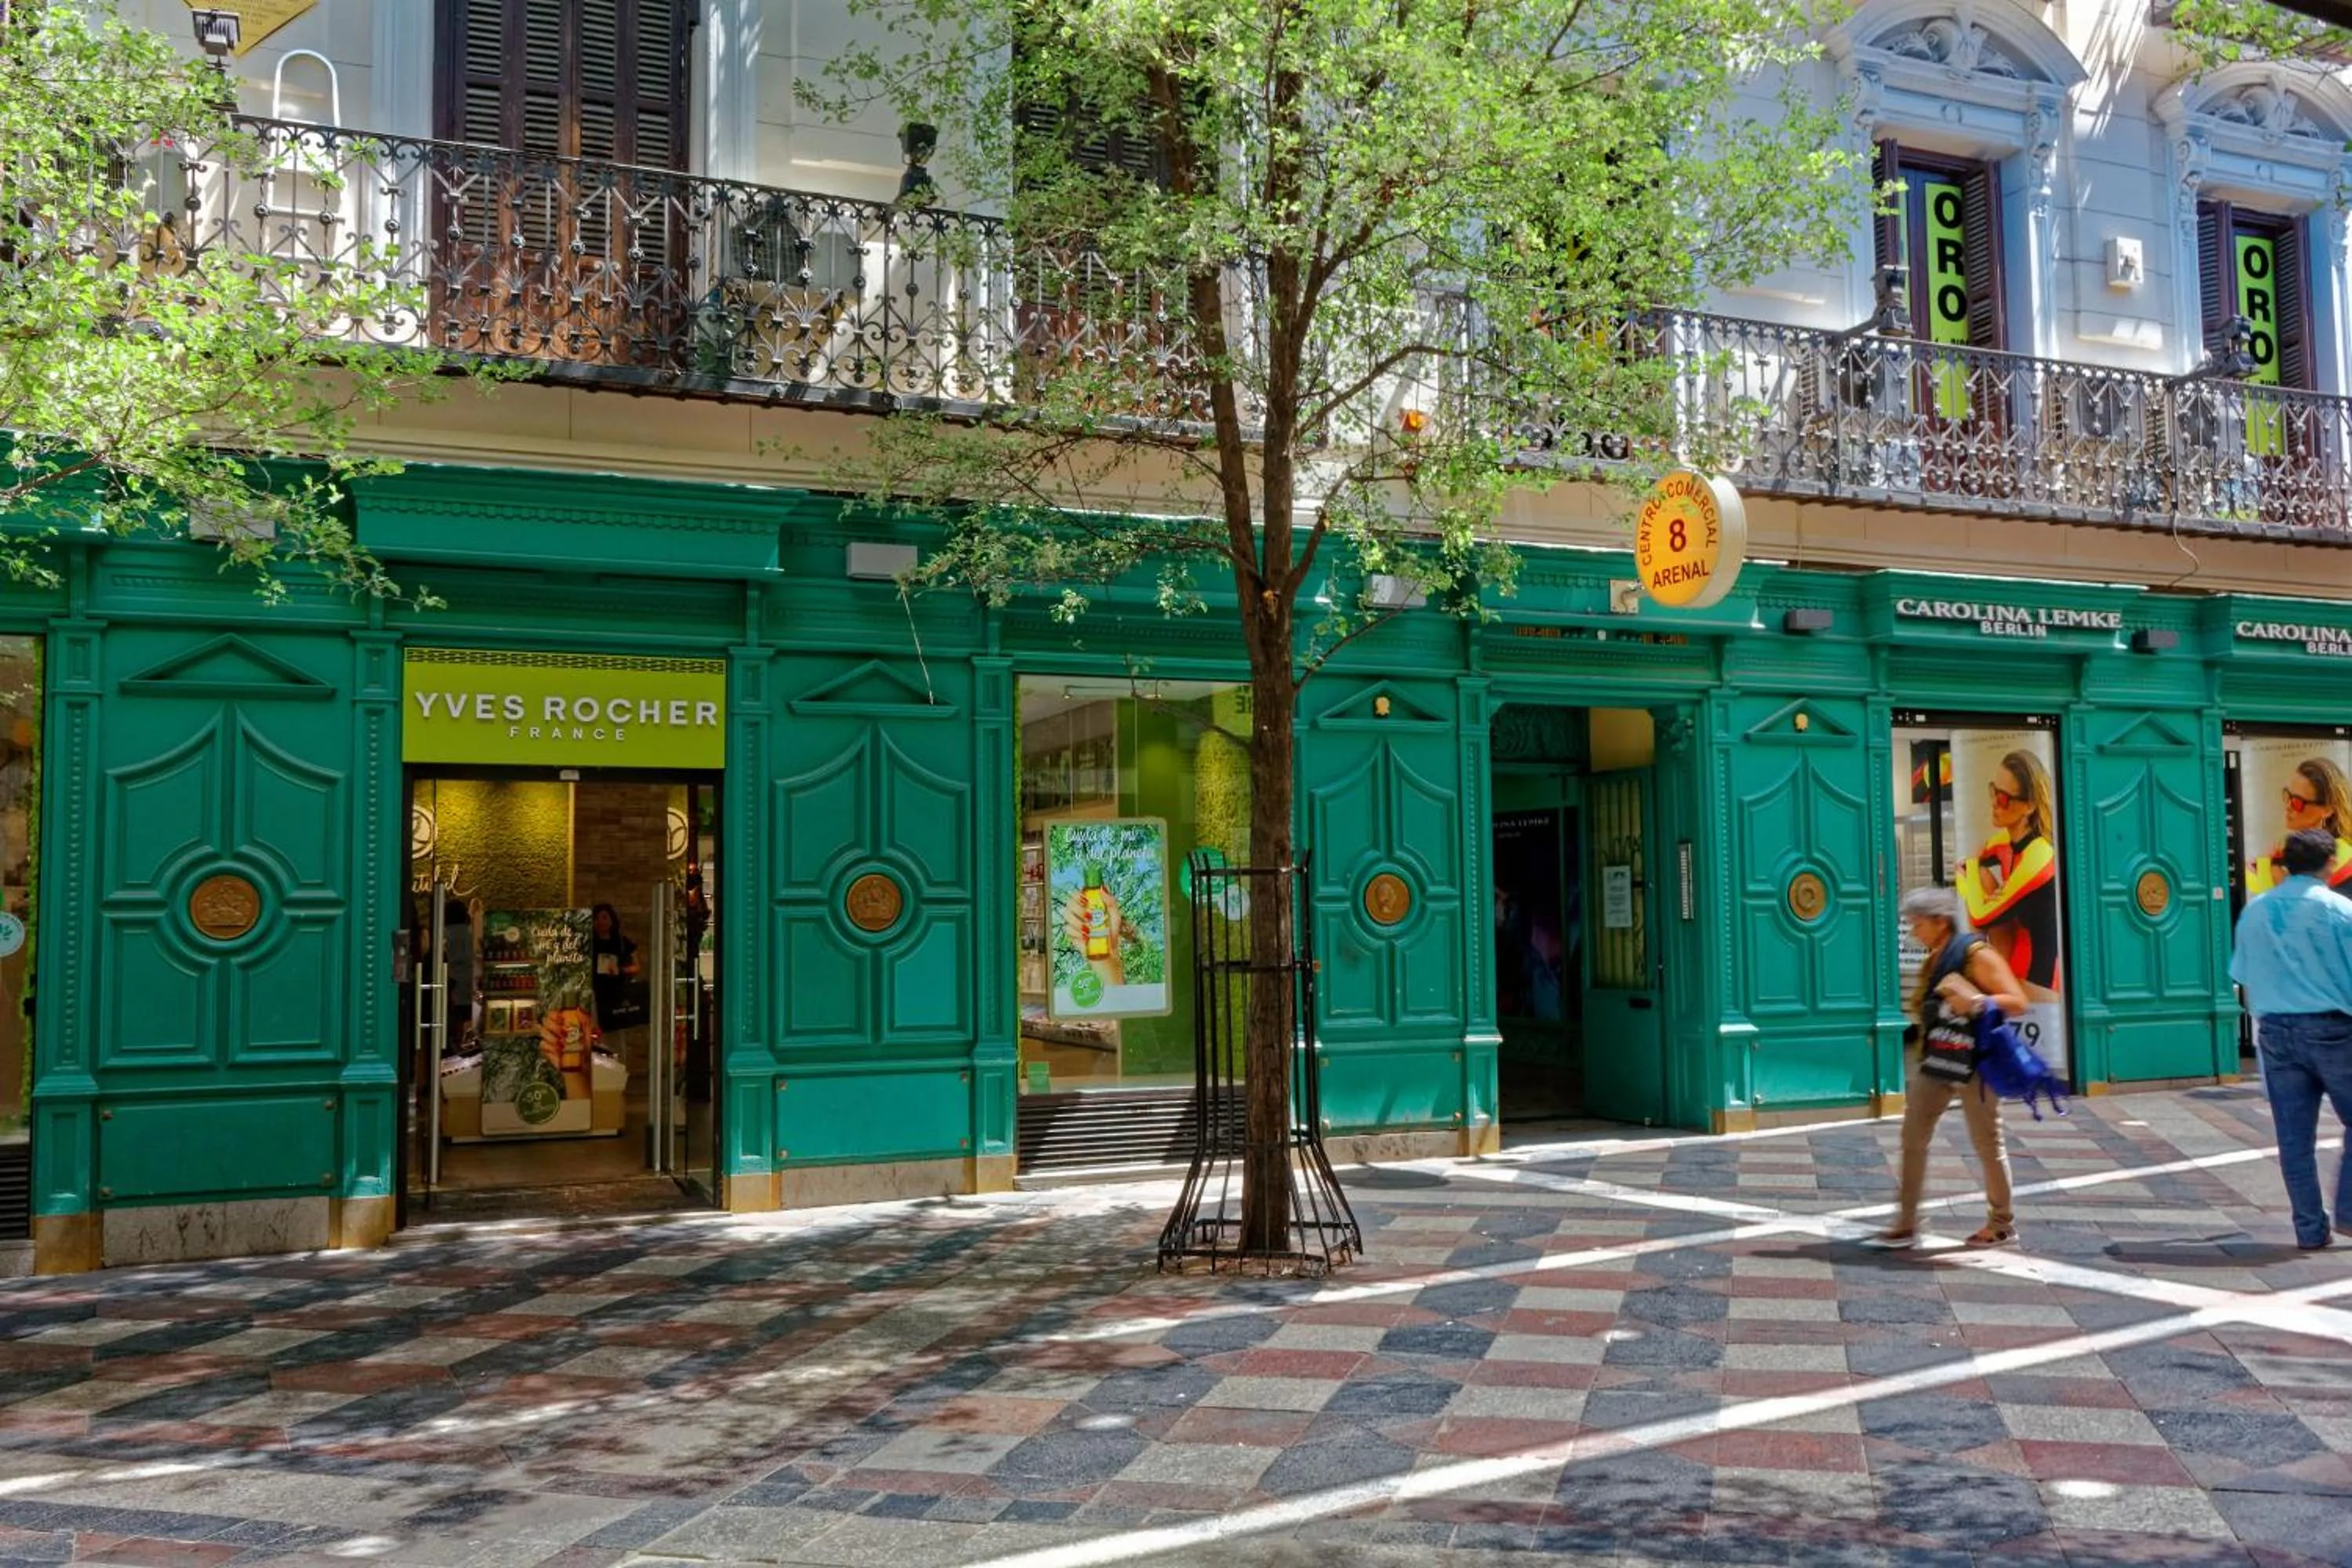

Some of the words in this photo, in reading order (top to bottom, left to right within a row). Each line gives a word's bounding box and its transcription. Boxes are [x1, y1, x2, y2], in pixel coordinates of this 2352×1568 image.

[1934, 191, 1968, 323] ORO
[2243, 245, 2274, 365] ORO
[1639, 494, 1661, 567] CENTRO
[1666, 480, 1718, 549] COMERCIAL
[1669, 518, 1687, 553] 8
[1652, 558, 1710, 590] ARENAL
[1896, 598, 2033, 623] CAROLINA
[2038, 608, 2123, 629] LEMKE
[1980, 620, 2048, 637] BERLIN
[2235, 621, 2352, 644] CAROLINA
[415, 691, 525, 720] YVES
[544, 696, 718, 727] ROCHER
[509, 727, 626, 741] FRANCE
